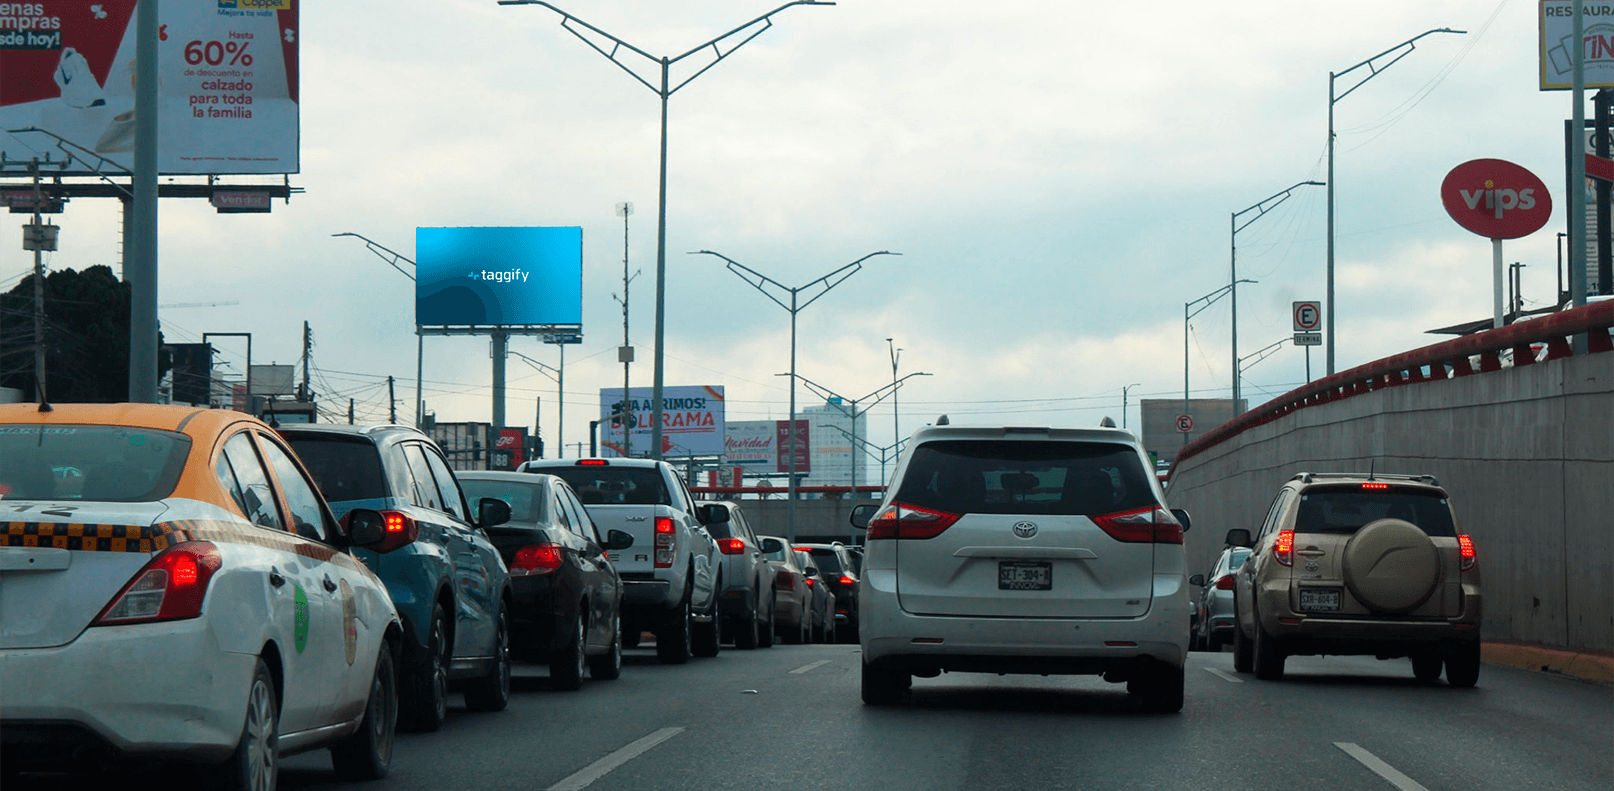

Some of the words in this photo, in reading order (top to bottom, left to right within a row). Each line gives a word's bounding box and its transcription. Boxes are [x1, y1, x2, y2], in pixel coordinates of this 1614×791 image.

[28, 31, 60, 48] hoy!
[228, 31, 254, 40] Hasta
[184, 40, 254, 66] 60%
[184, 68, 195, 76] de
[196, 68, 240, 77] descuento
[202, 79, 253, 91] calzado
[189, 95, 219, 106] para
[222, 93, 253, 105] toda
[193, 106, 204, 118] la
[207, 106, 252, 119] familia
[1460, 180, 1536, 220] vips
[481, 268, 530, 282] taggify
[1302, 308, 1312, 324] E
[642, 398, 706, 411] ARIMOS!
[723, 434, 772, 452] Navidad
